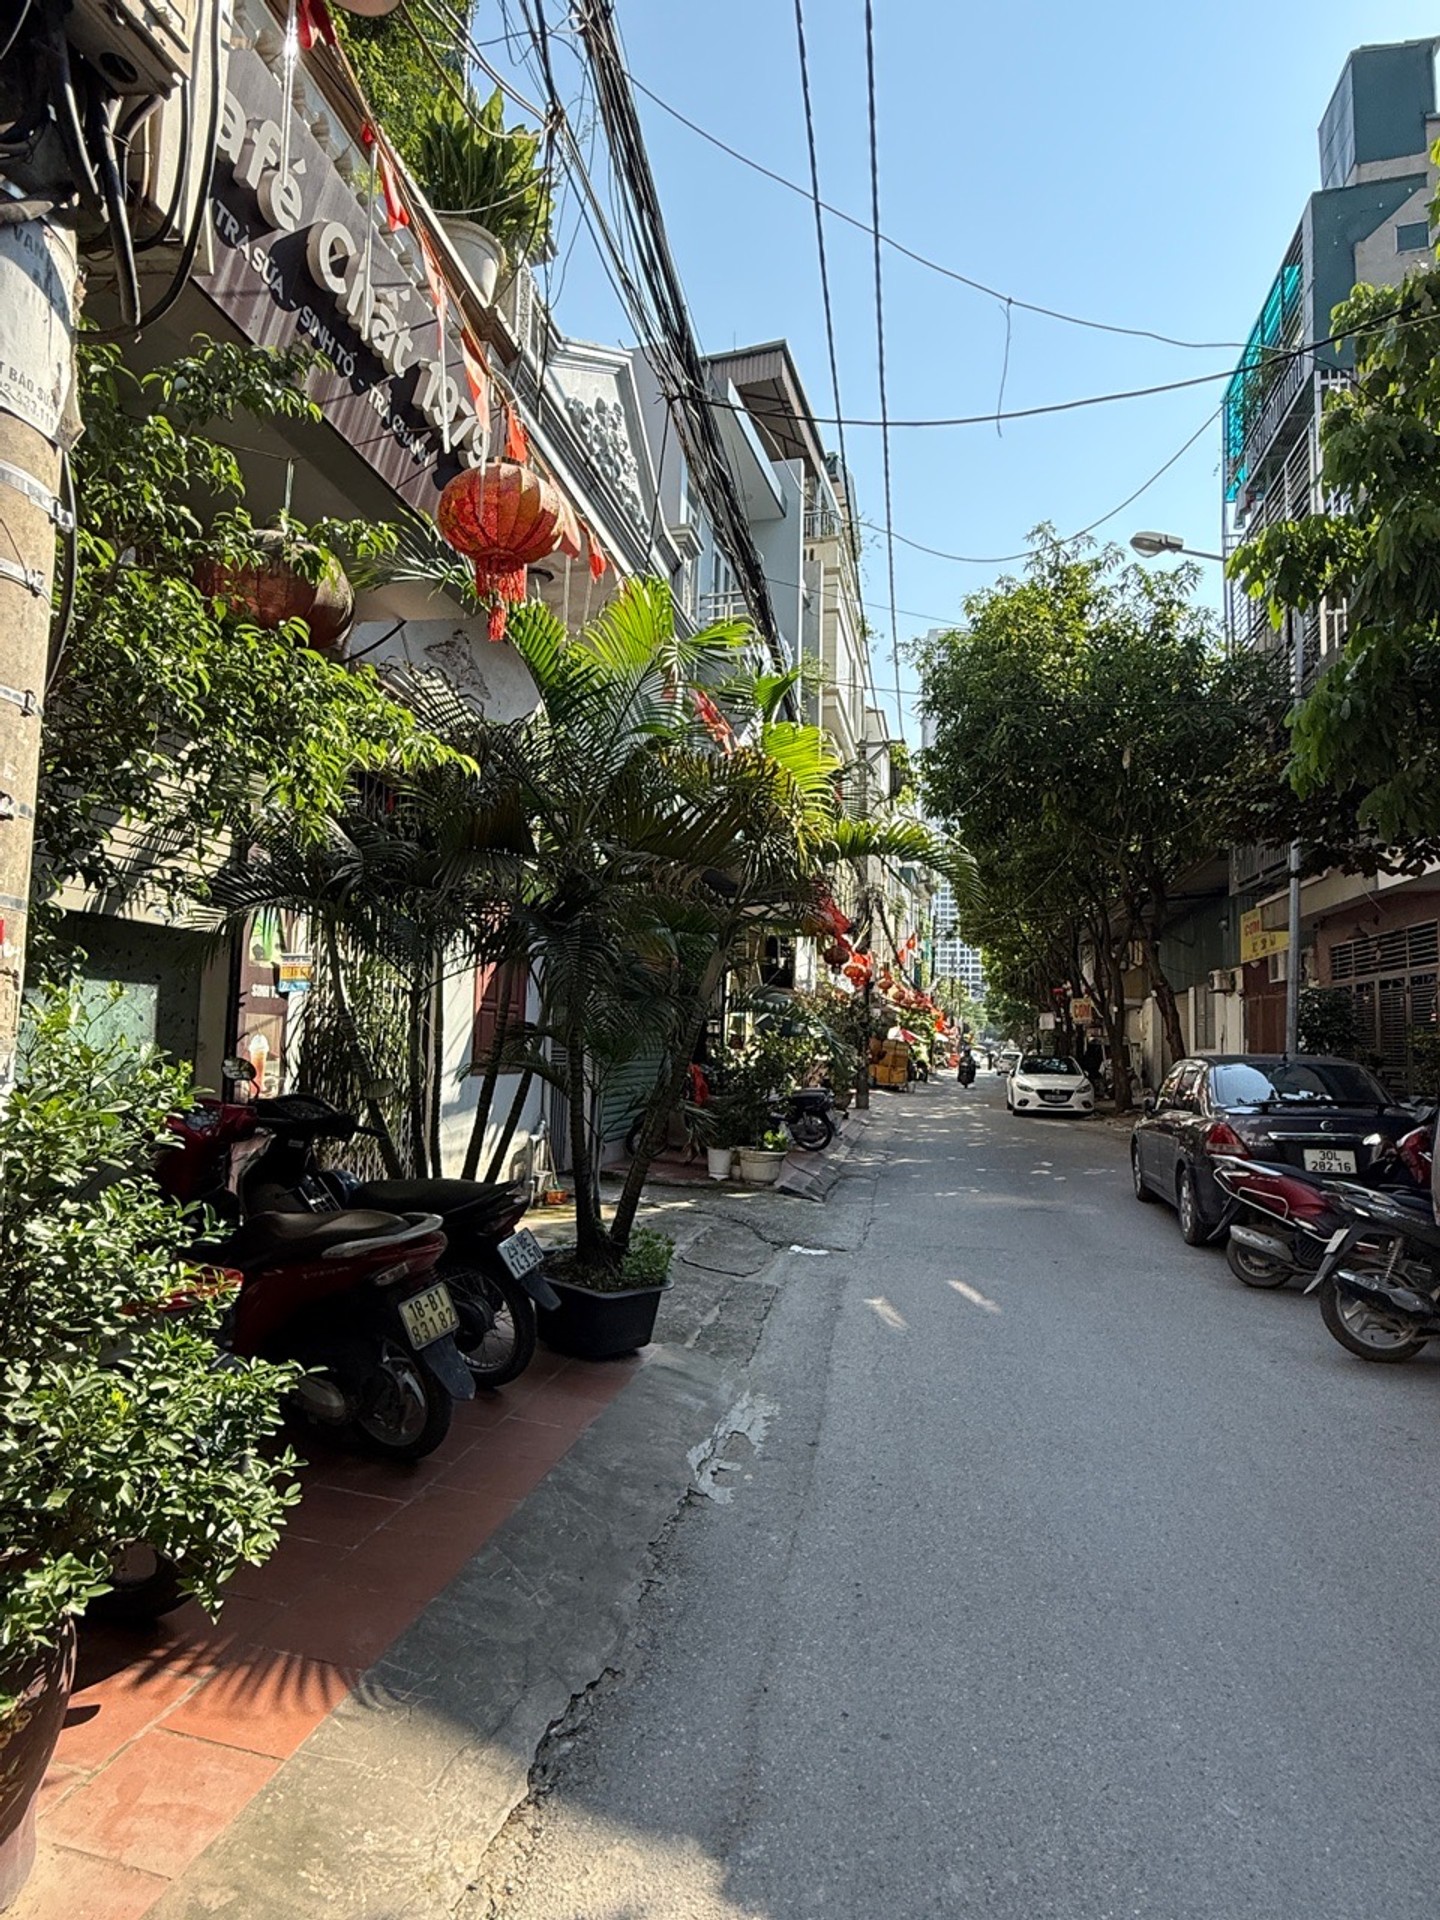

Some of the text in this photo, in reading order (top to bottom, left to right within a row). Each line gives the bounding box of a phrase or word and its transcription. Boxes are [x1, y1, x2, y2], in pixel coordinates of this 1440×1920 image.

[216, 89, 307, 231] afé
[216, 200, 250, 261] TRÀ
[301, 305, 336, 355] SINH
[336, 343, 358, 376] TỐ
[1319, 1150, 1341, 1161] 30L
[408, 1289, 445, 1321] 18-B1
